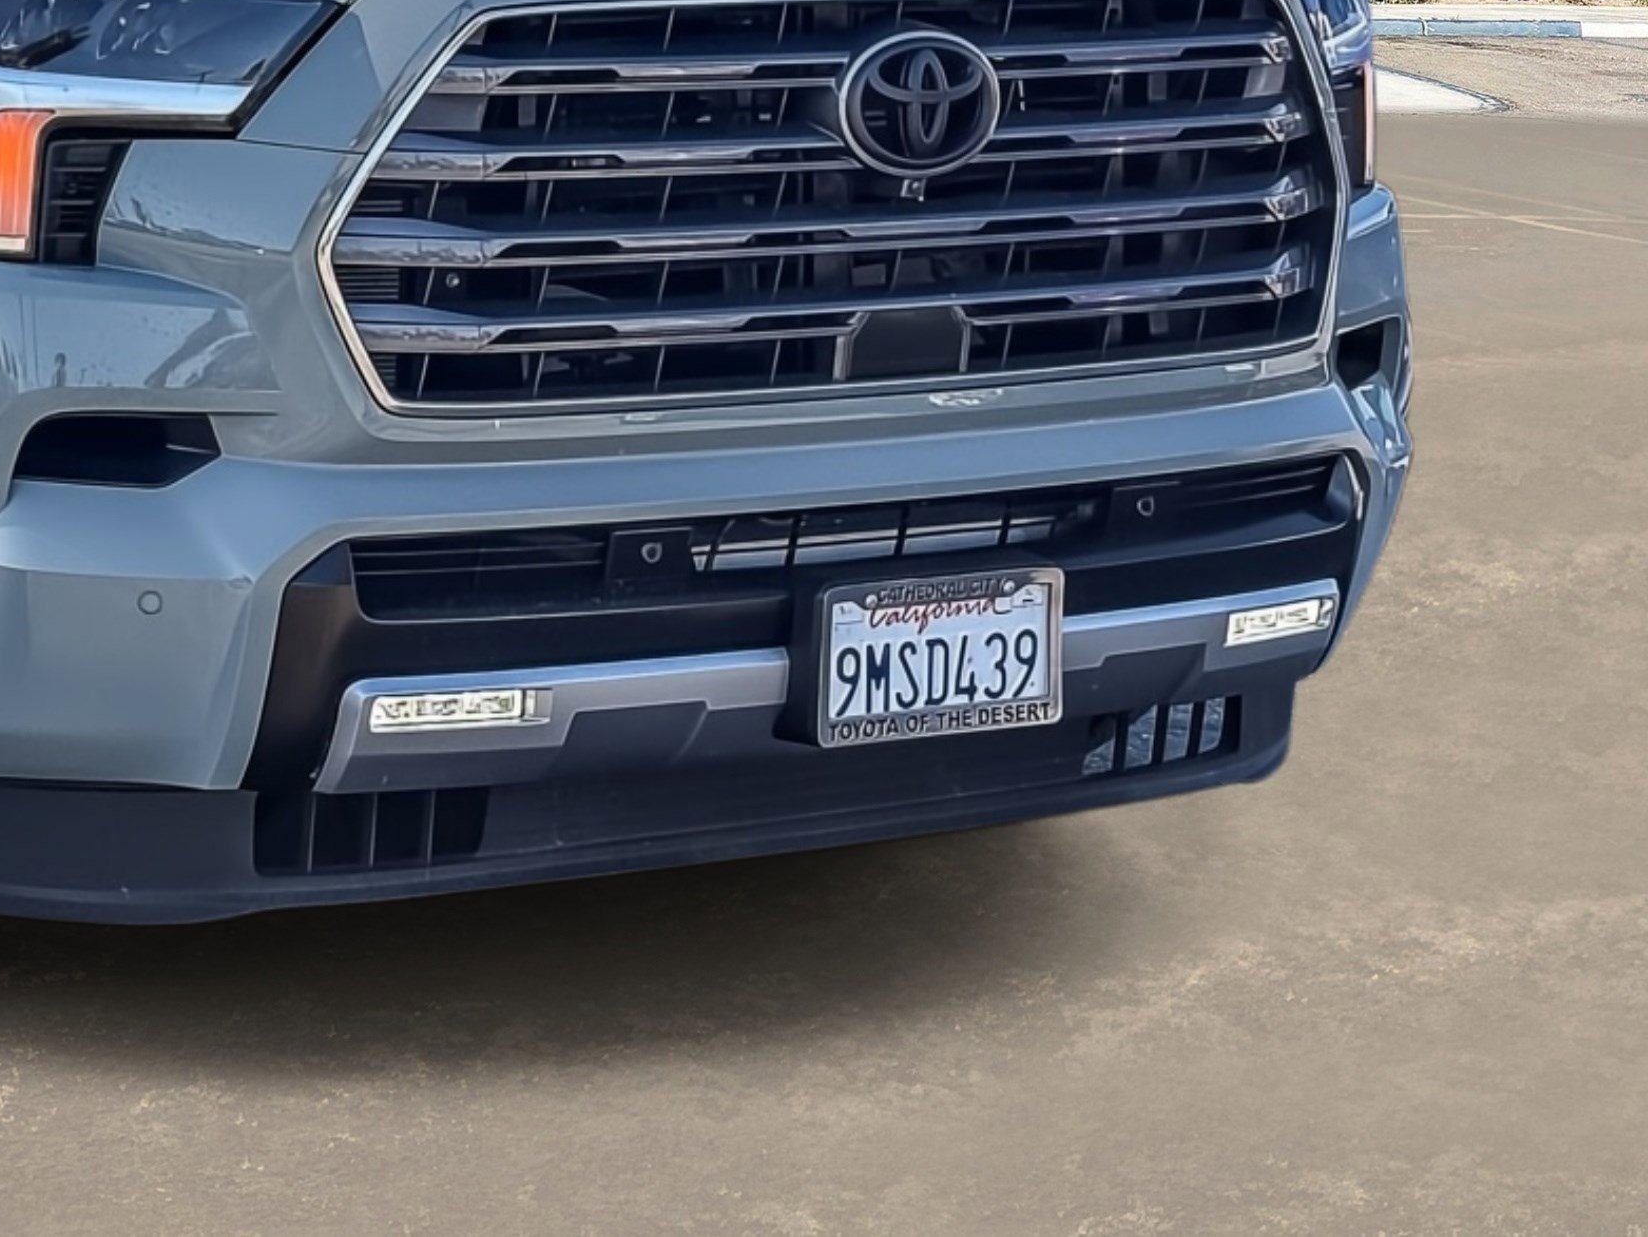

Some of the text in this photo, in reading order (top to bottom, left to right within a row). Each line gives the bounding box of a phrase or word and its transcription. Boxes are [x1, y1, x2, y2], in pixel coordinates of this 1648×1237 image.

[836, 628, 1038, 718] 9MSD439
[829, 701, 1053, 742] TOYOTA OF THE DESERT
